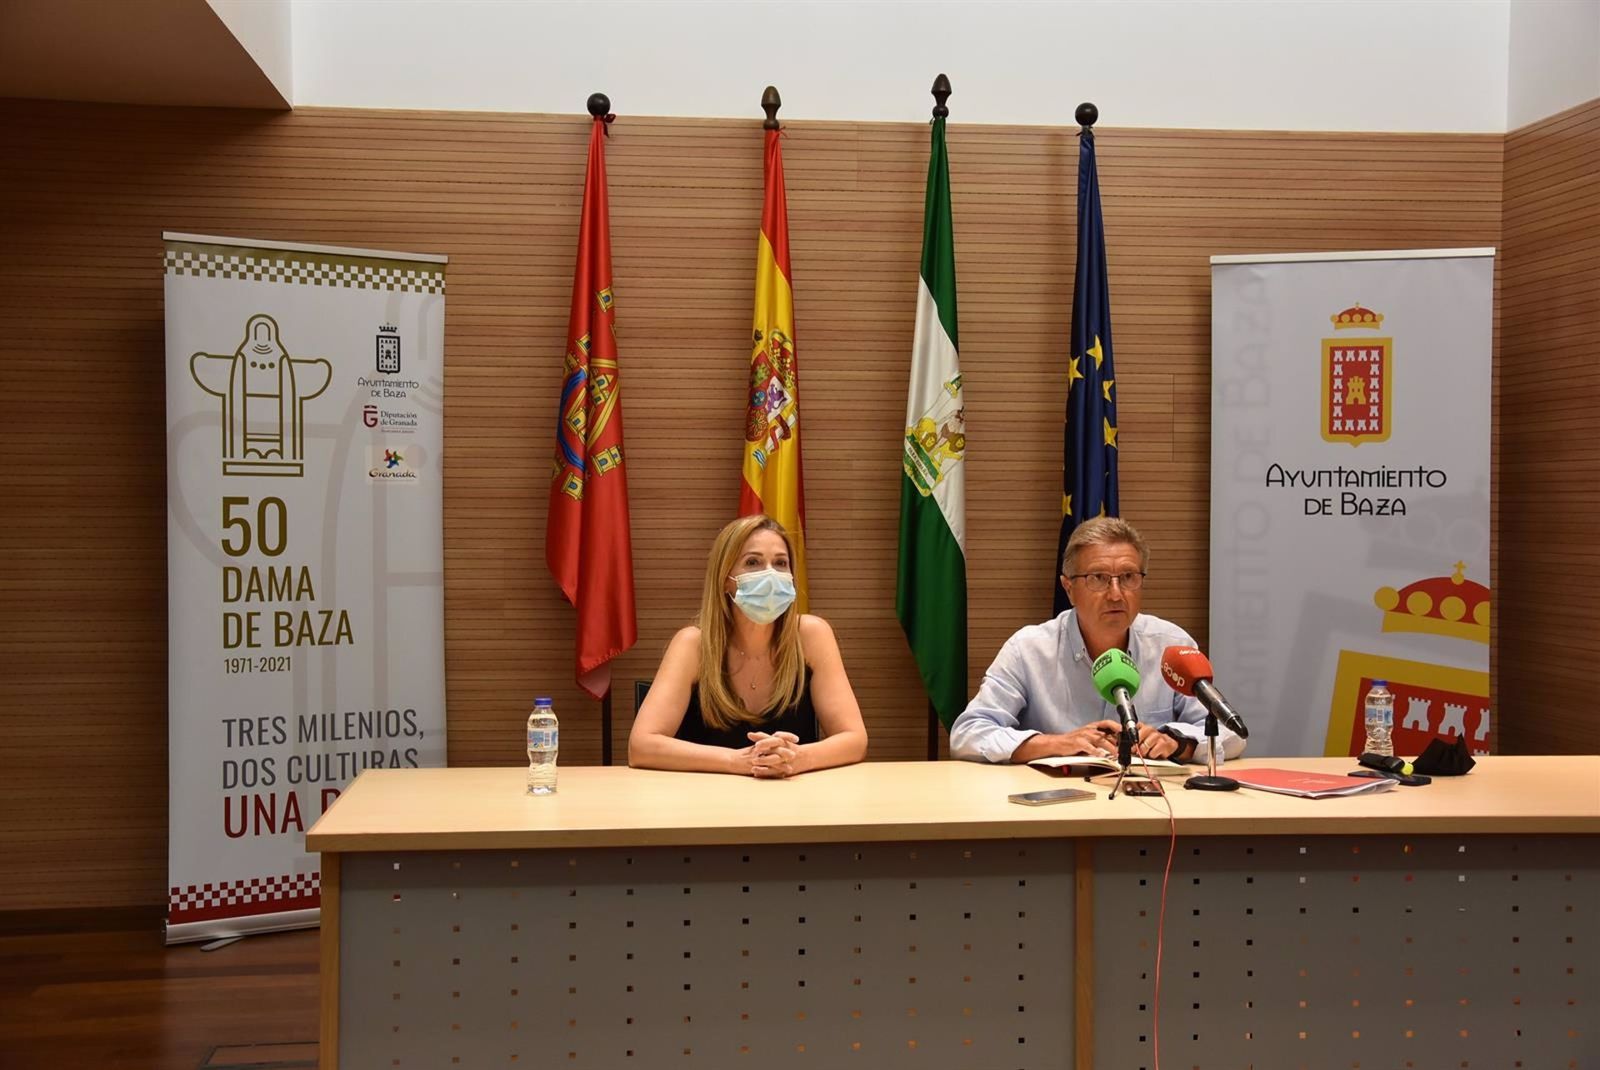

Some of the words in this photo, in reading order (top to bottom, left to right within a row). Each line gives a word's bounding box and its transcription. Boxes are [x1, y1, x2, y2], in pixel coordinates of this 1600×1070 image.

[370, 389, 382, 398] DE
[383, 388, 407, 398] BAZA
[380, 410, 418, 419] Diputación
[389, 419, 418, 427] Granada
[368, 468, 417, 479] Granada
[1303, 498, 1333, 516] DE
[1340, 492, 1407, 517] BAZA
[221, 496, 288, 557] 50
[222, 565, 316, 603] DAMA
[222, 611, 262, 649] DE
[273, 609, 355, 648] BAZA
[223, 656, 292, 674] 1971-2021
[222, 715, 288, 748] TRES
[298, 708, 425, 743] MILENIOS,
[222, 757, 277, 790] DOS
[223, 791, 305, 839] UNA
